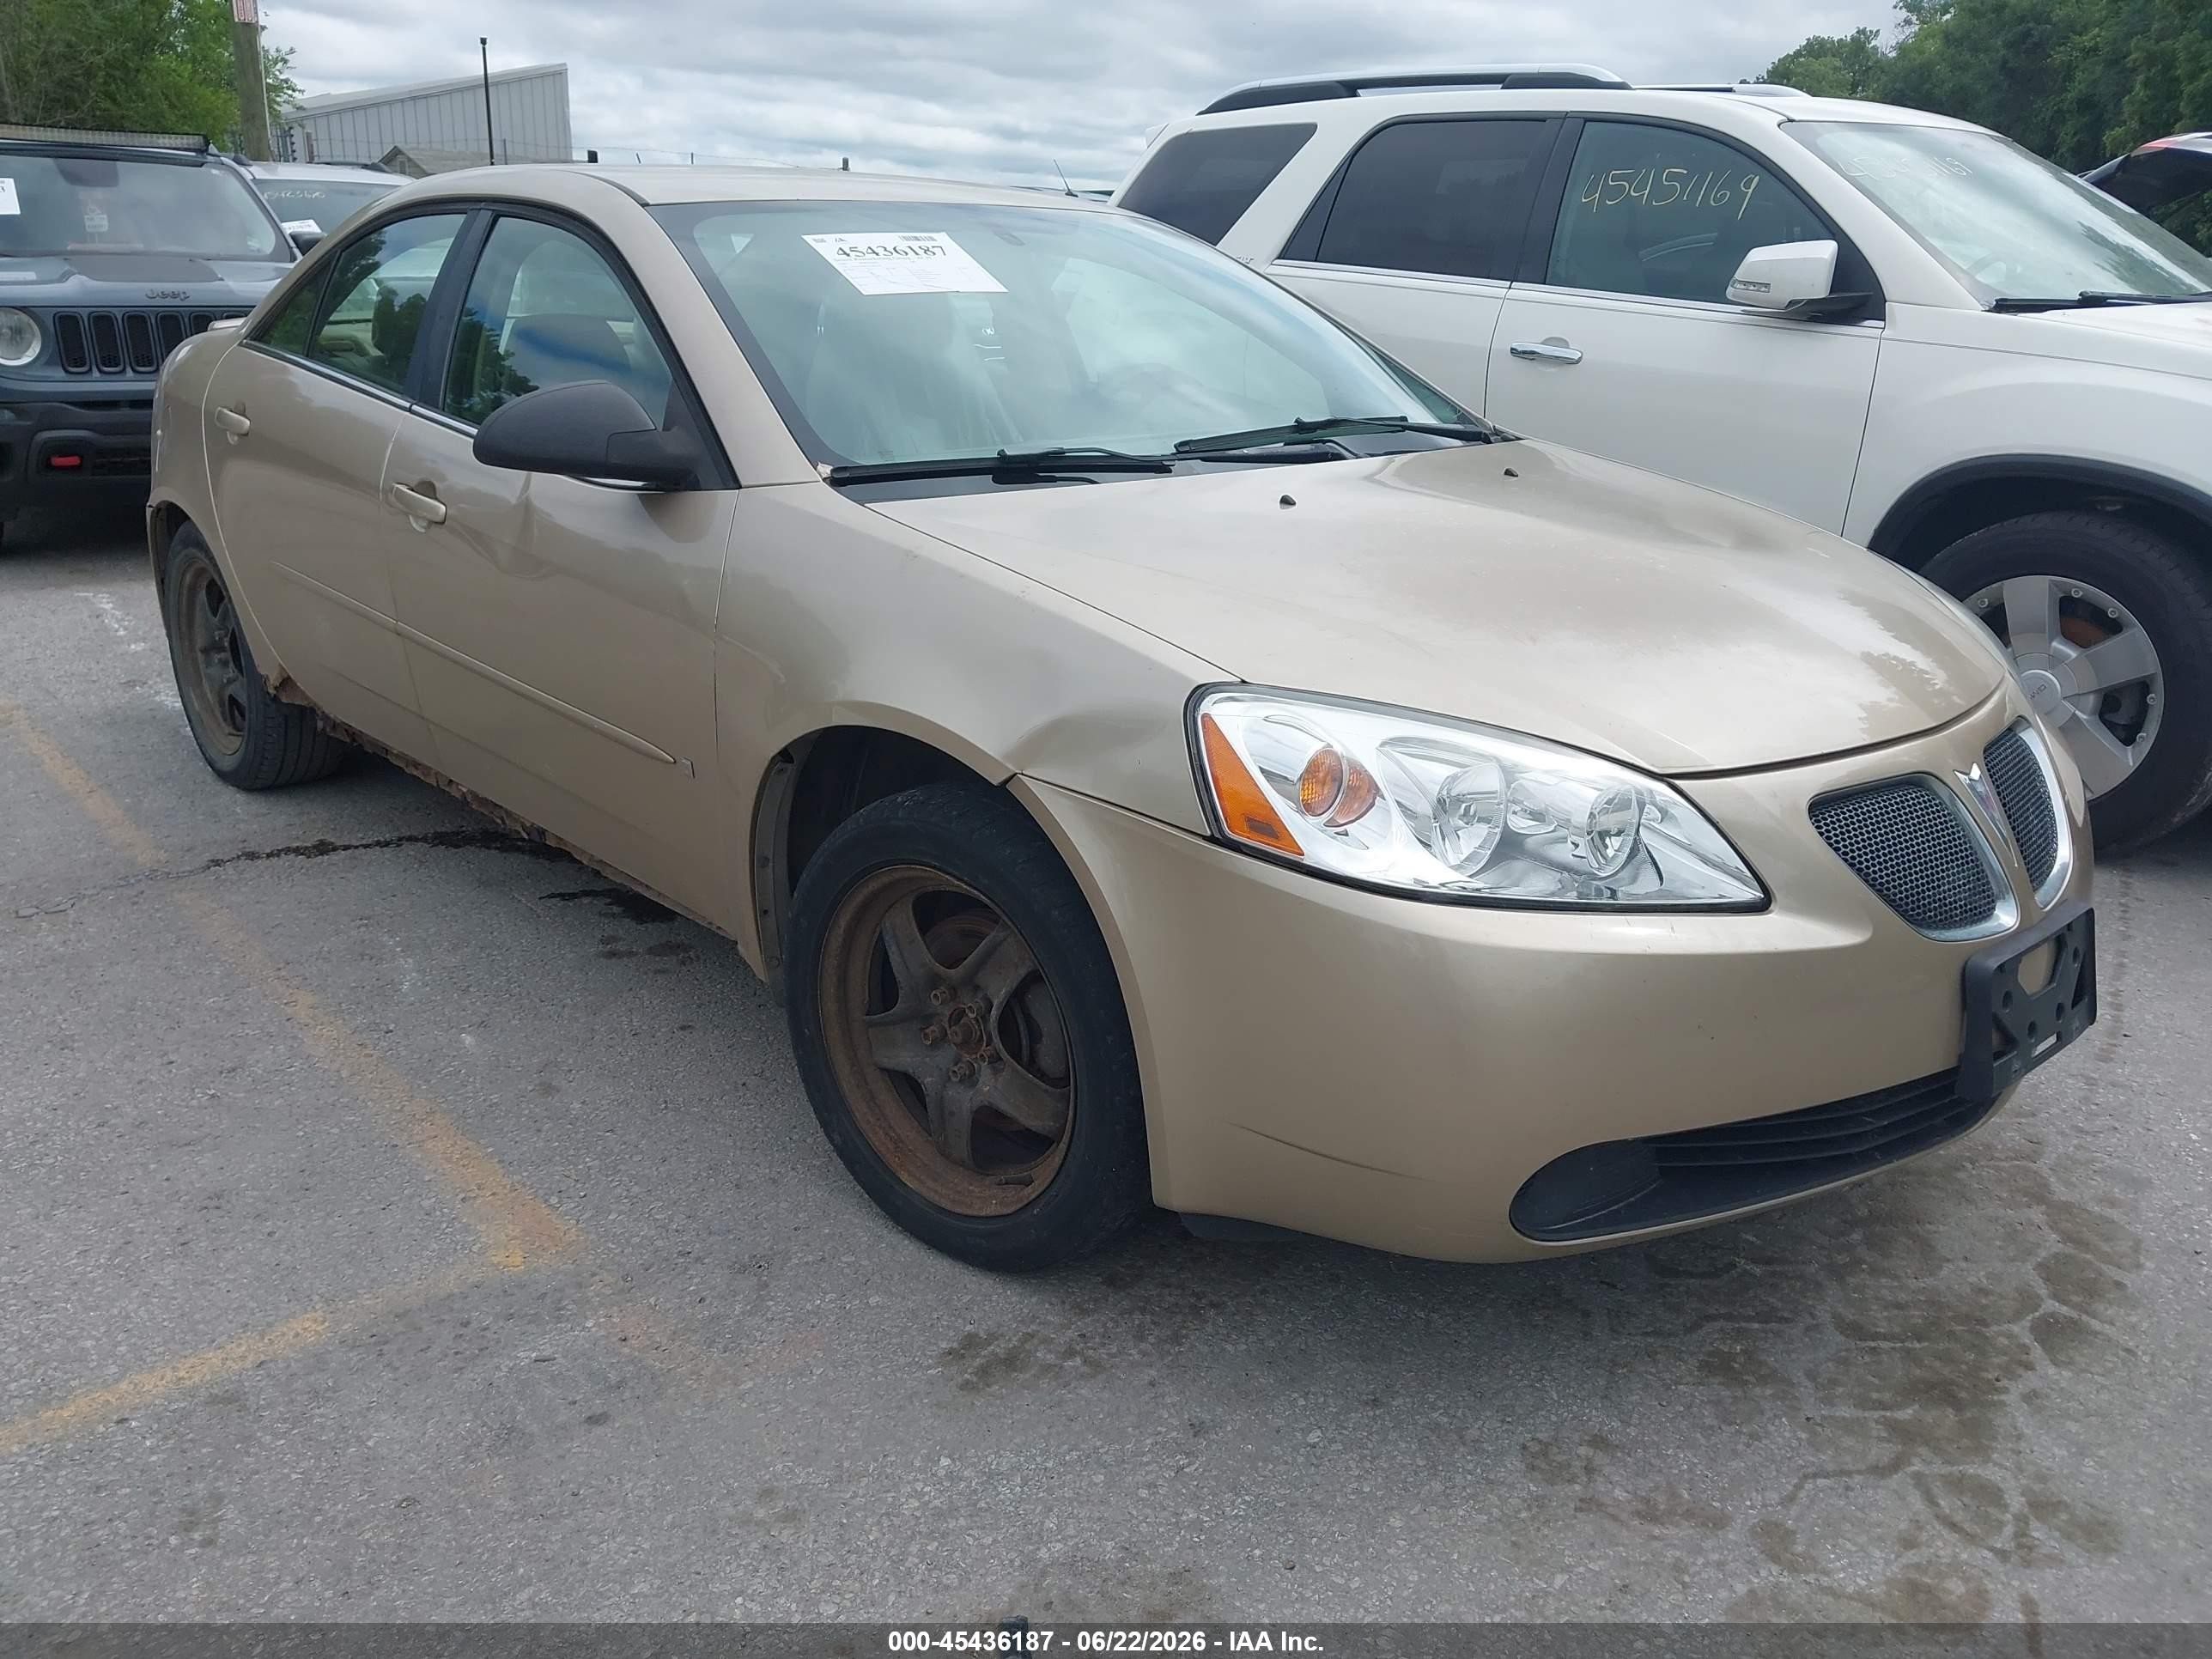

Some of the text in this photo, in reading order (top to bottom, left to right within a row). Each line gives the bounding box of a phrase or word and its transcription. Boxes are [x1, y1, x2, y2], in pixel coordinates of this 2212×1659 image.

[1581, 168, 1760, 221] 45451169
[836, 246, 947, 258] 45436187
[144, 288, 191, 301] Jeep
